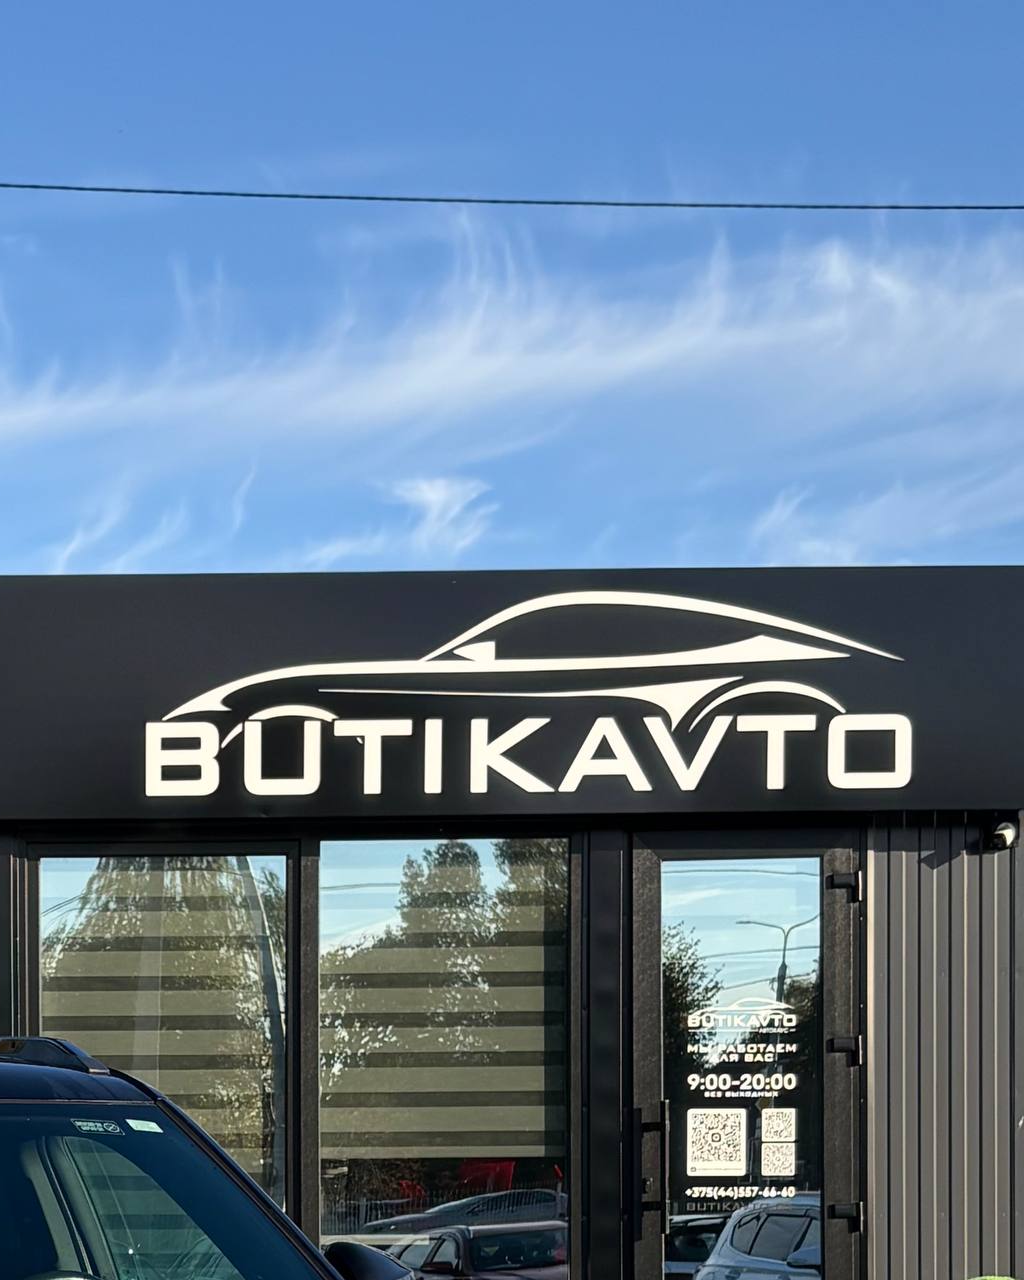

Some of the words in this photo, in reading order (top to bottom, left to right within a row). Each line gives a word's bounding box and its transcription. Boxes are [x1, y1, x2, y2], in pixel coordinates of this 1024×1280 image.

[144, 712, 914, 798] BUTIKAVTO
[687, 1014, 797, 1028] BUTIKAVTO
[716, 1043, 797, 1053] РАБОТАЕМ
[744, 1053, 774, 1062] ВАС
[687, 1073, 797, 1091] 9:00-20:00
